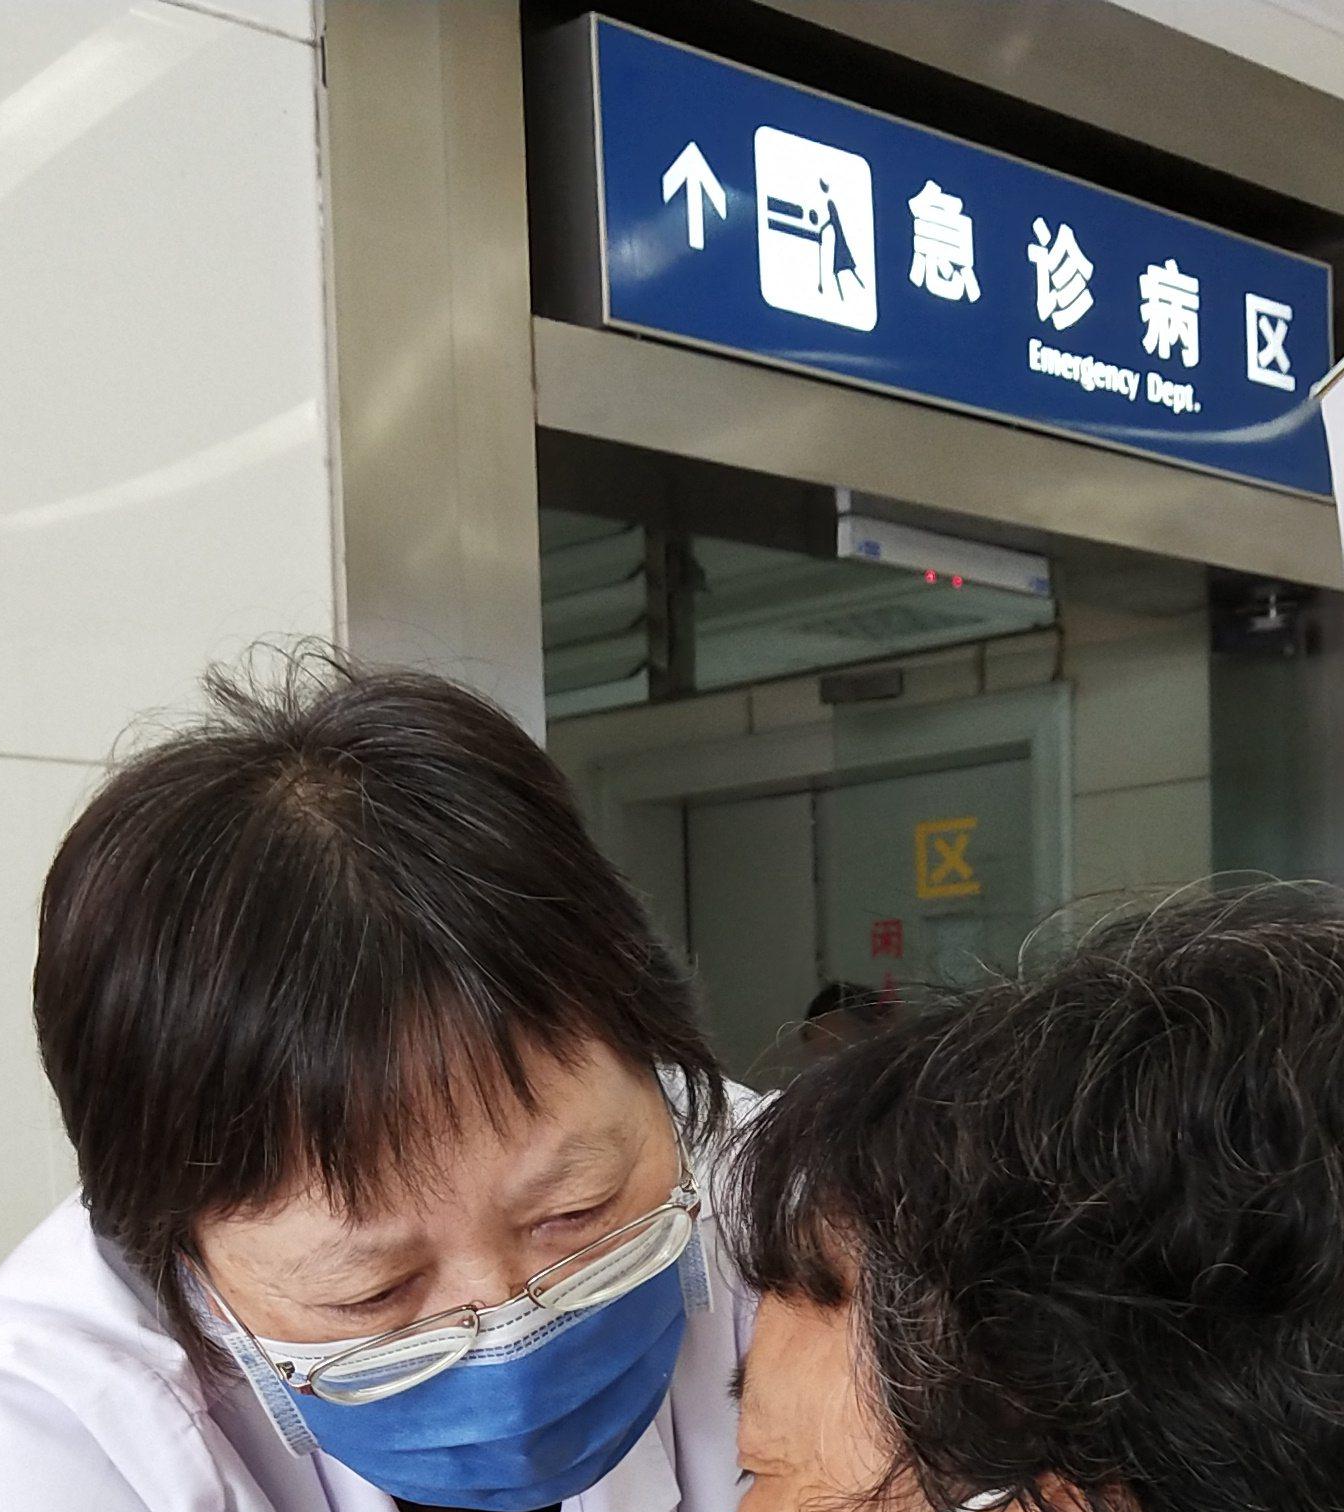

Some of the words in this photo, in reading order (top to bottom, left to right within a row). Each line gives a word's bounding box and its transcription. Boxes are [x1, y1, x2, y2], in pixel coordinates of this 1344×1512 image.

[907, 179, 1296, 392] 急诊病区
[1029, 338, 1141, 401] Emergency
[1146, 371, 1202, 414] Dept.
[915, 815, 981, 898] 区
